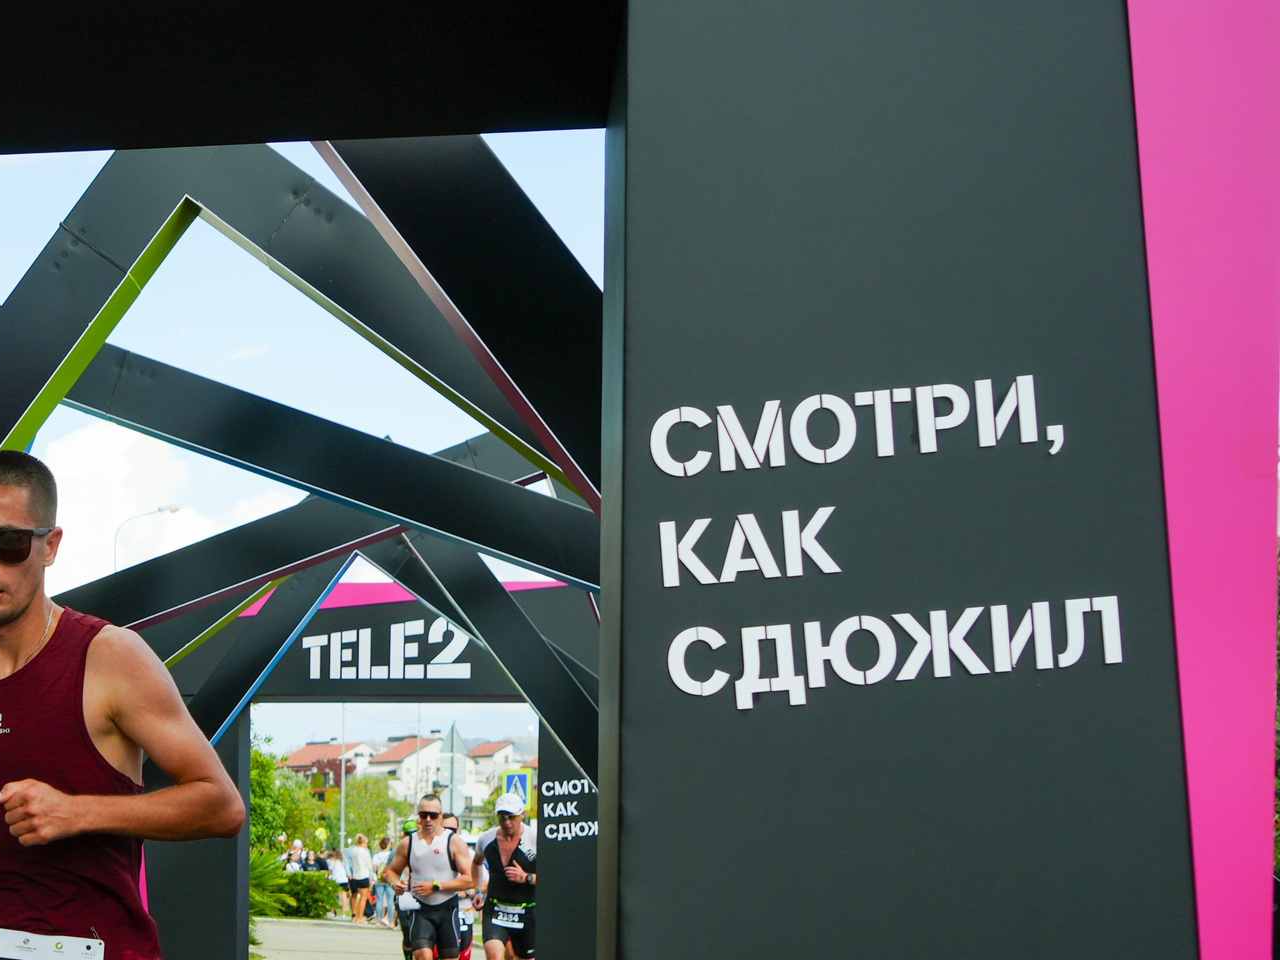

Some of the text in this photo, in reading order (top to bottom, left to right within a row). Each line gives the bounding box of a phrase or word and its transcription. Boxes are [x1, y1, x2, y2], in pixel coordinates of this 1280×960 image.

[650, 375, 1065, 477] СМОТРИ,
[659, 506, 842, 588] КАК
[302, 616, 472, 680] TELE2
[667, 595, 1123, 710] СДЮЖИЛ
[541, 779, 596, 797] СМОТ
[543, 801, 579, 818] КАК
